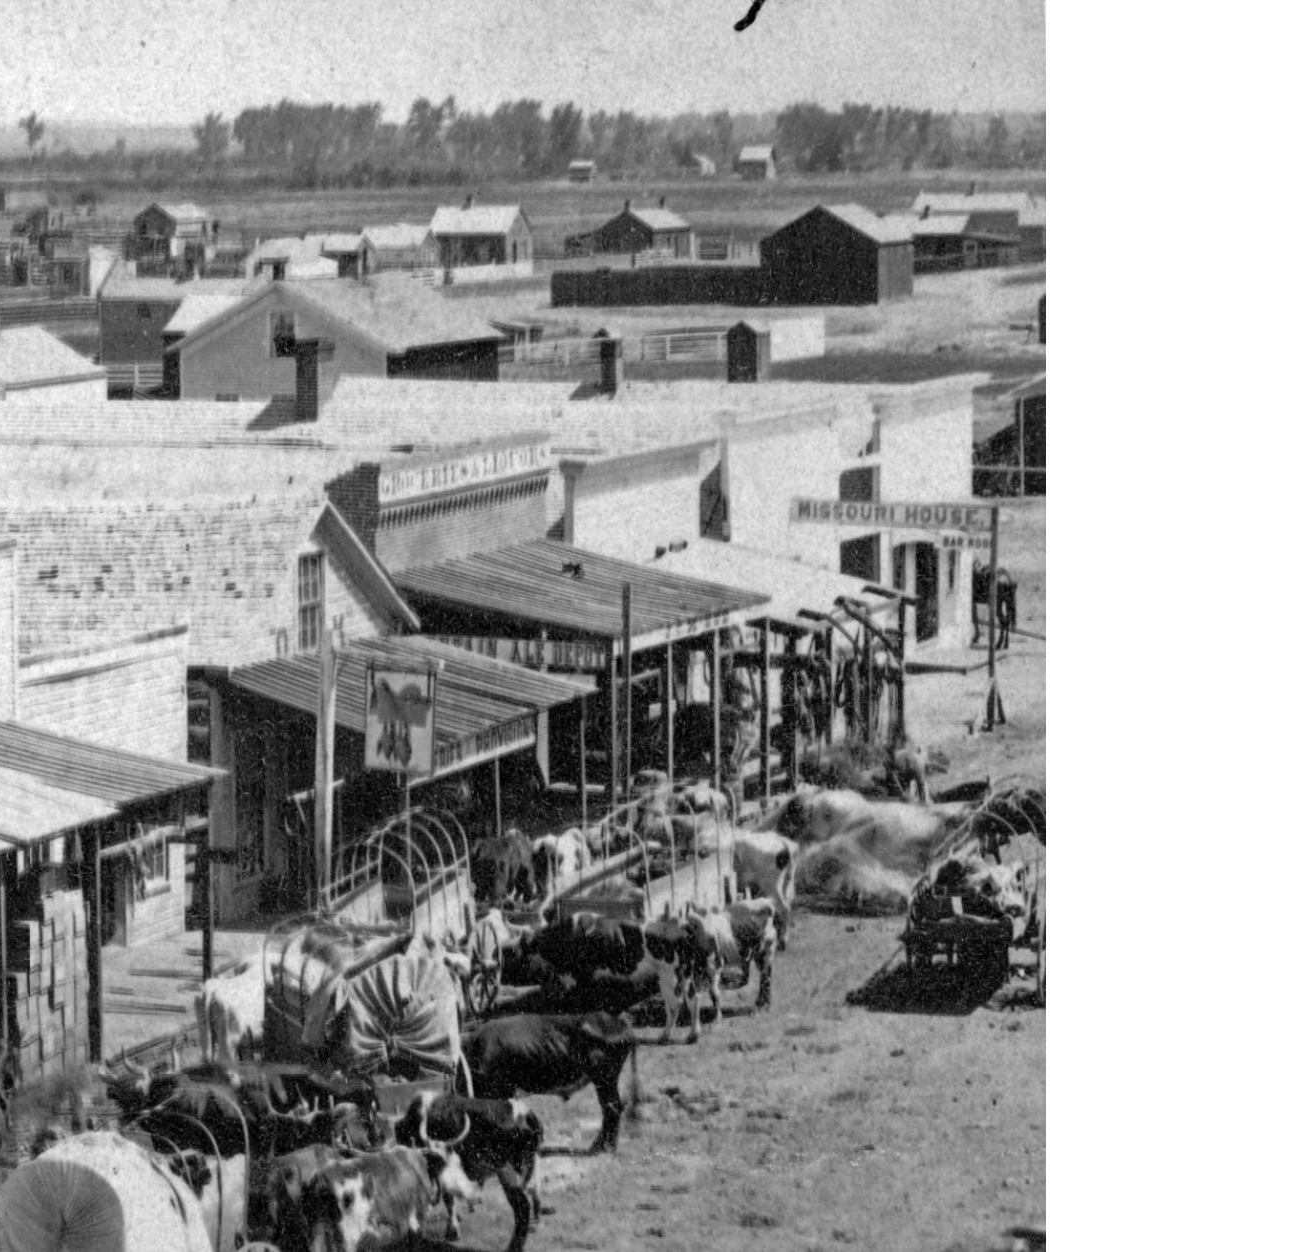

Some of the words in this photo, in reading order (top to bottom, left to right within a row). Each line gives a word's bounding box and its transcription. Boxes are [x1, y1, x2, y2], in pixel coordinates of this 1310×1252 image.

[797, 501, 895, 521] MISSOURI
[942, 535, 964, 548] BAR
[968, 536, 990, 549] ROO
